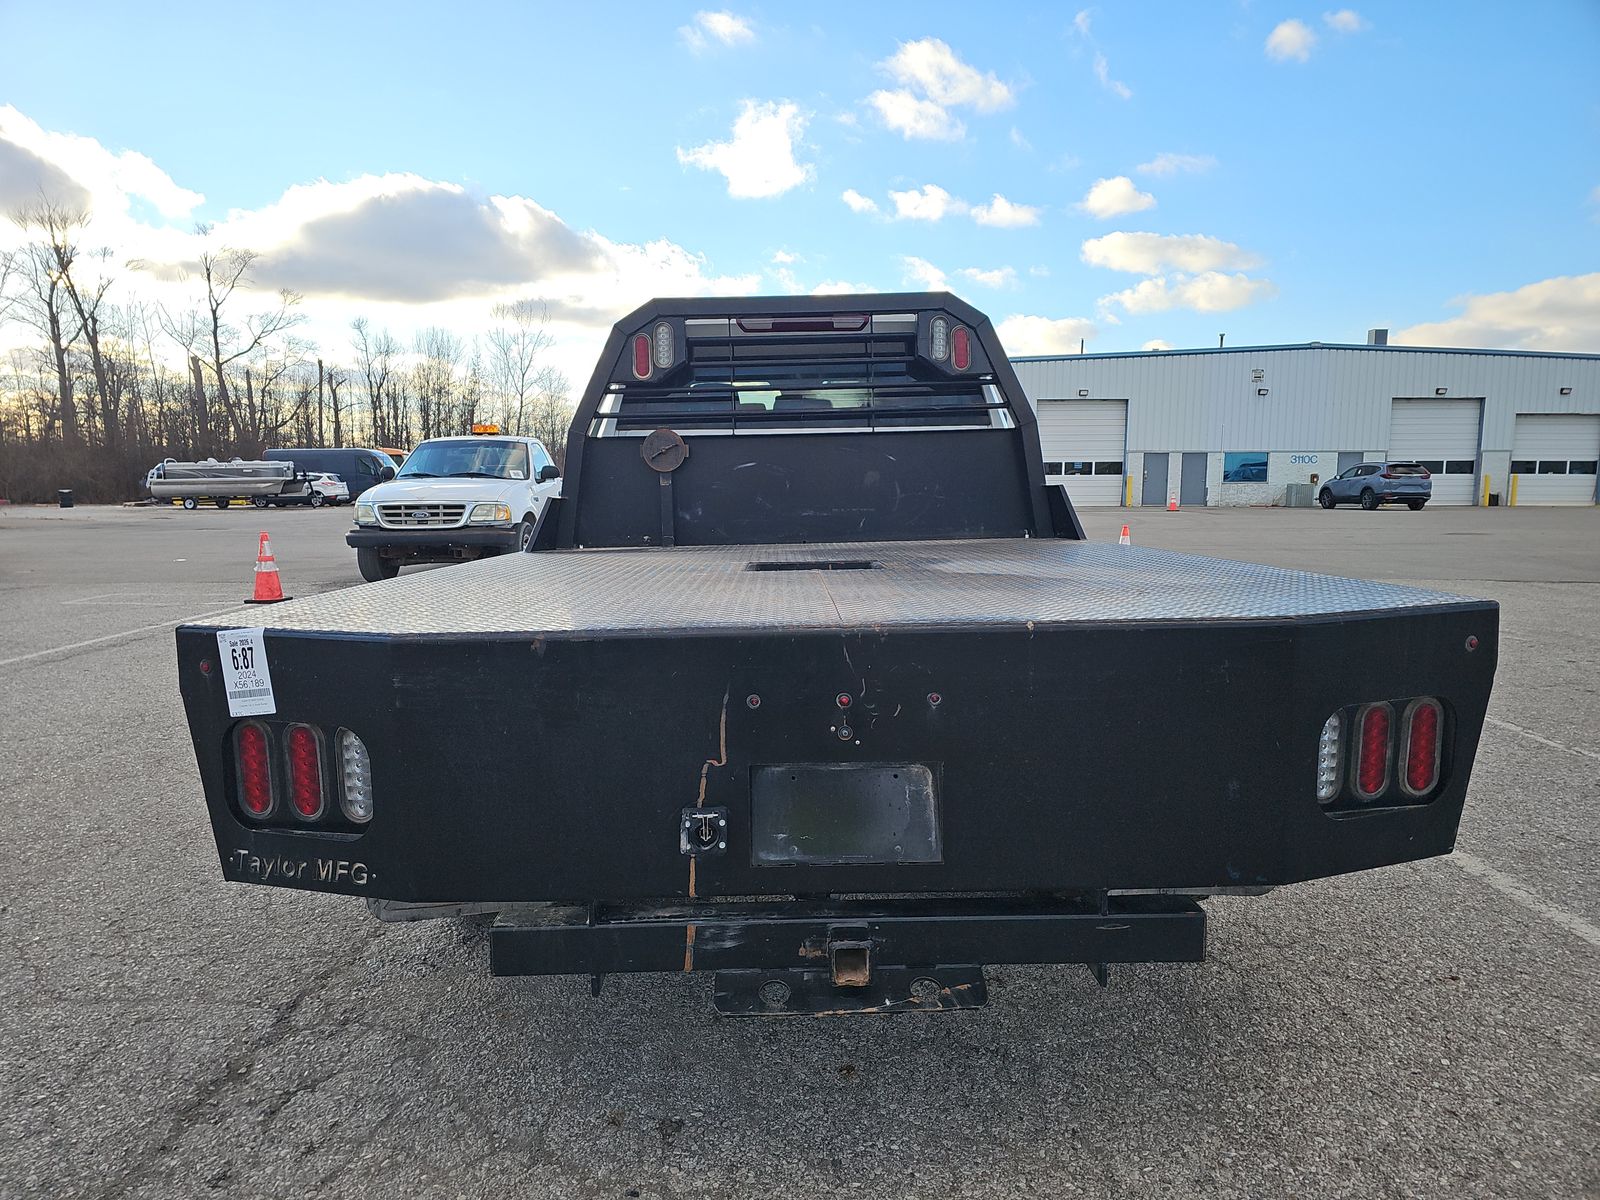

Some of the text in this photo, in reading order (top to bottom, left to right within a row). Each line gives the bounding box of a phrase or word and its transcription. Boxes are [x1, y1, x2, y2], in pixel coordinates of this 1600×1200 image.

[1290, 454, 1318, 465] 3110C
[231, 647, 254, 670] 6:87
[238, 670, 256, 680] 2024
[233, 848, 368, 885] Taylor MFG
